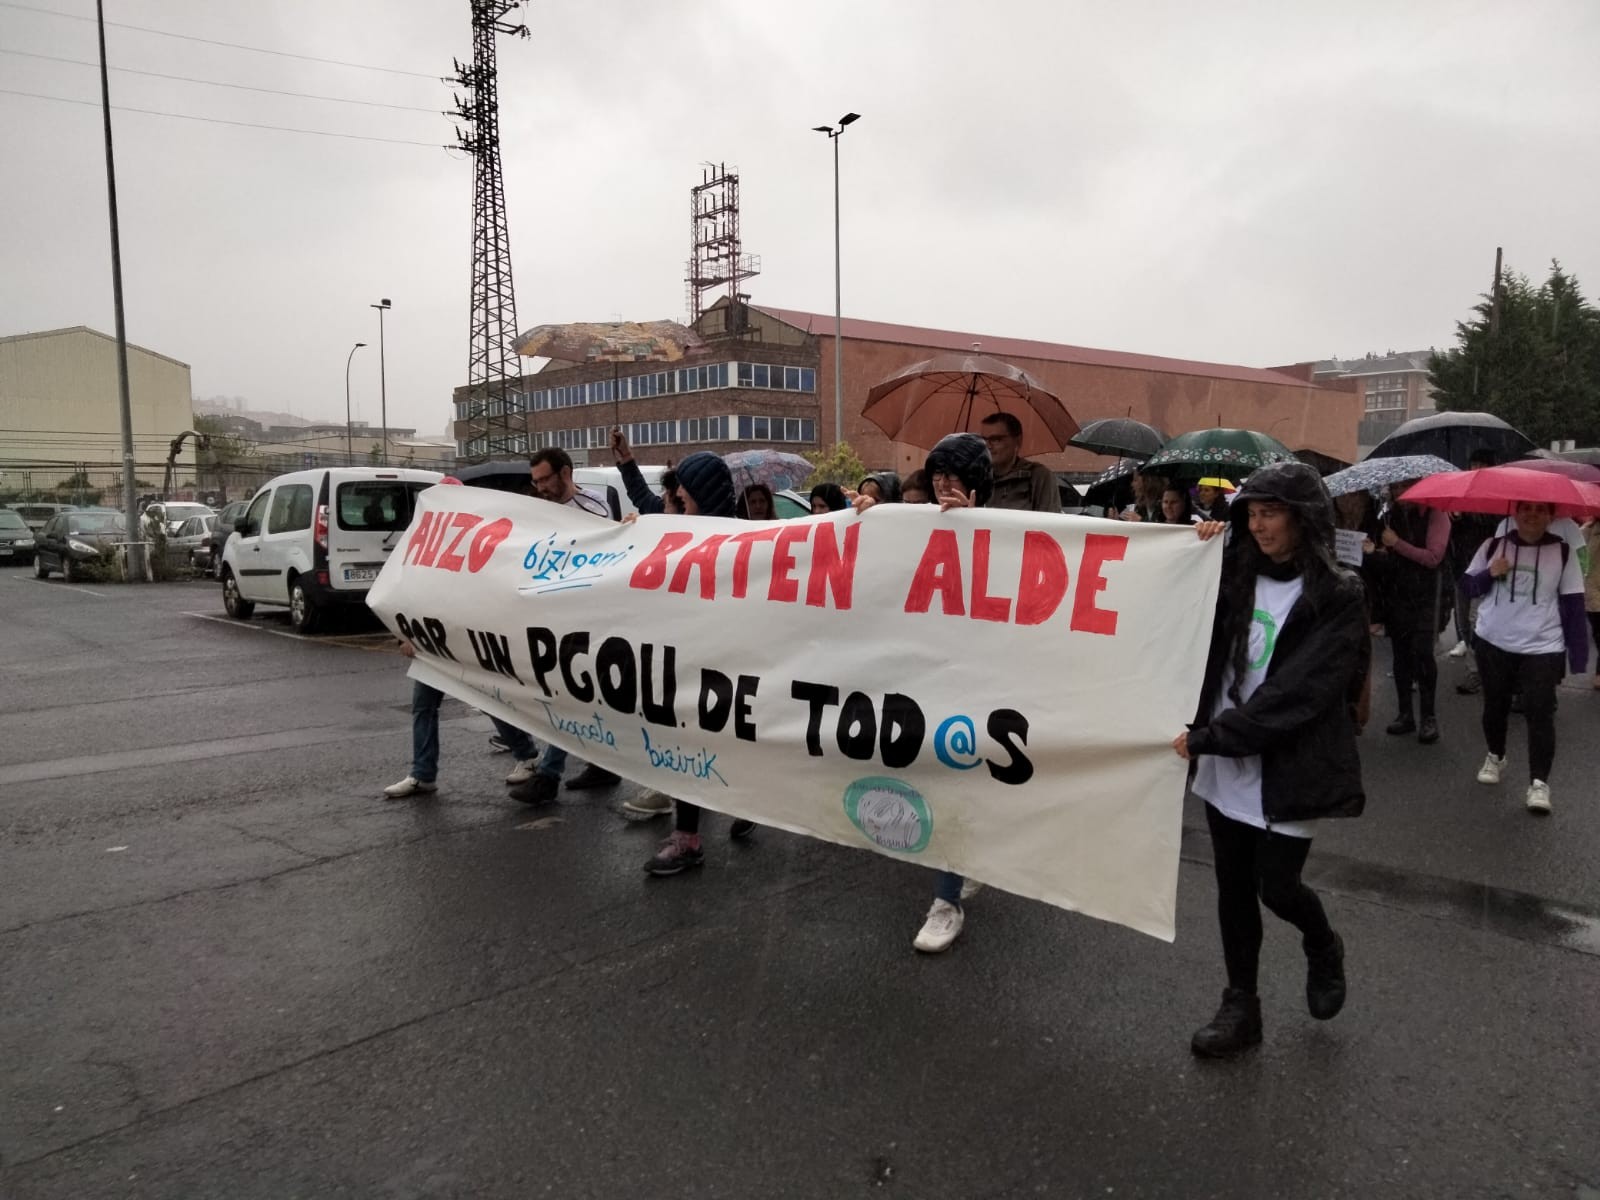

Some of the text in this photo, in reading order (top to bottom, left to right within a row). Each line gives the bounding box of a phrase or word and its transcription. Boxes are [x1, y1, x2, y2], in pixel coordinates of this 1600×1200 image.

[402, 511, 513, 574] AUZO
[629, 522, 860, 610] BATEN
[904, 529, 1129, 636] ALDE
[466, 628, 525, 686] UN
[698, 668, 761, 743] DE
[791, 679, 1035, 785] TOD@S
